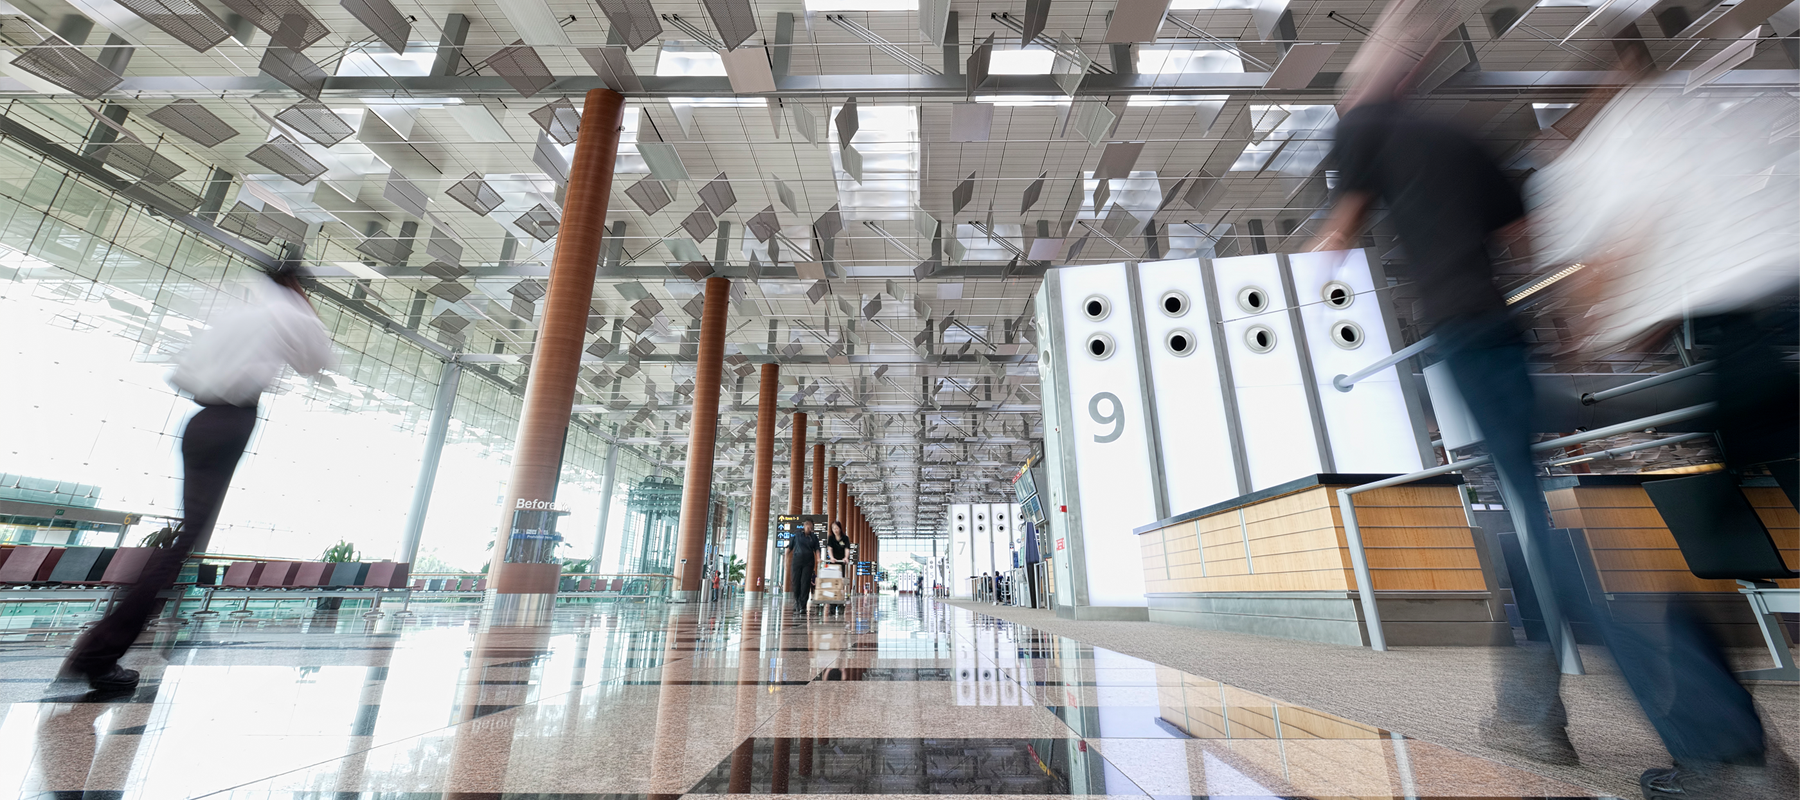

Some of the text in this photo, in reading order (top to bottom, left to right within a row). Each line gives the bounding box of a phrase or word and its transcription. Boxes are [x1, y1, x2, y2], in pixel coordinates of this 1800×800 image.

[1088, 391, 1125, 443] 9
[515, 498, 555, 509] Before
[124, 513, 132, 525] 6
[957, 541, 966, 555] 7
